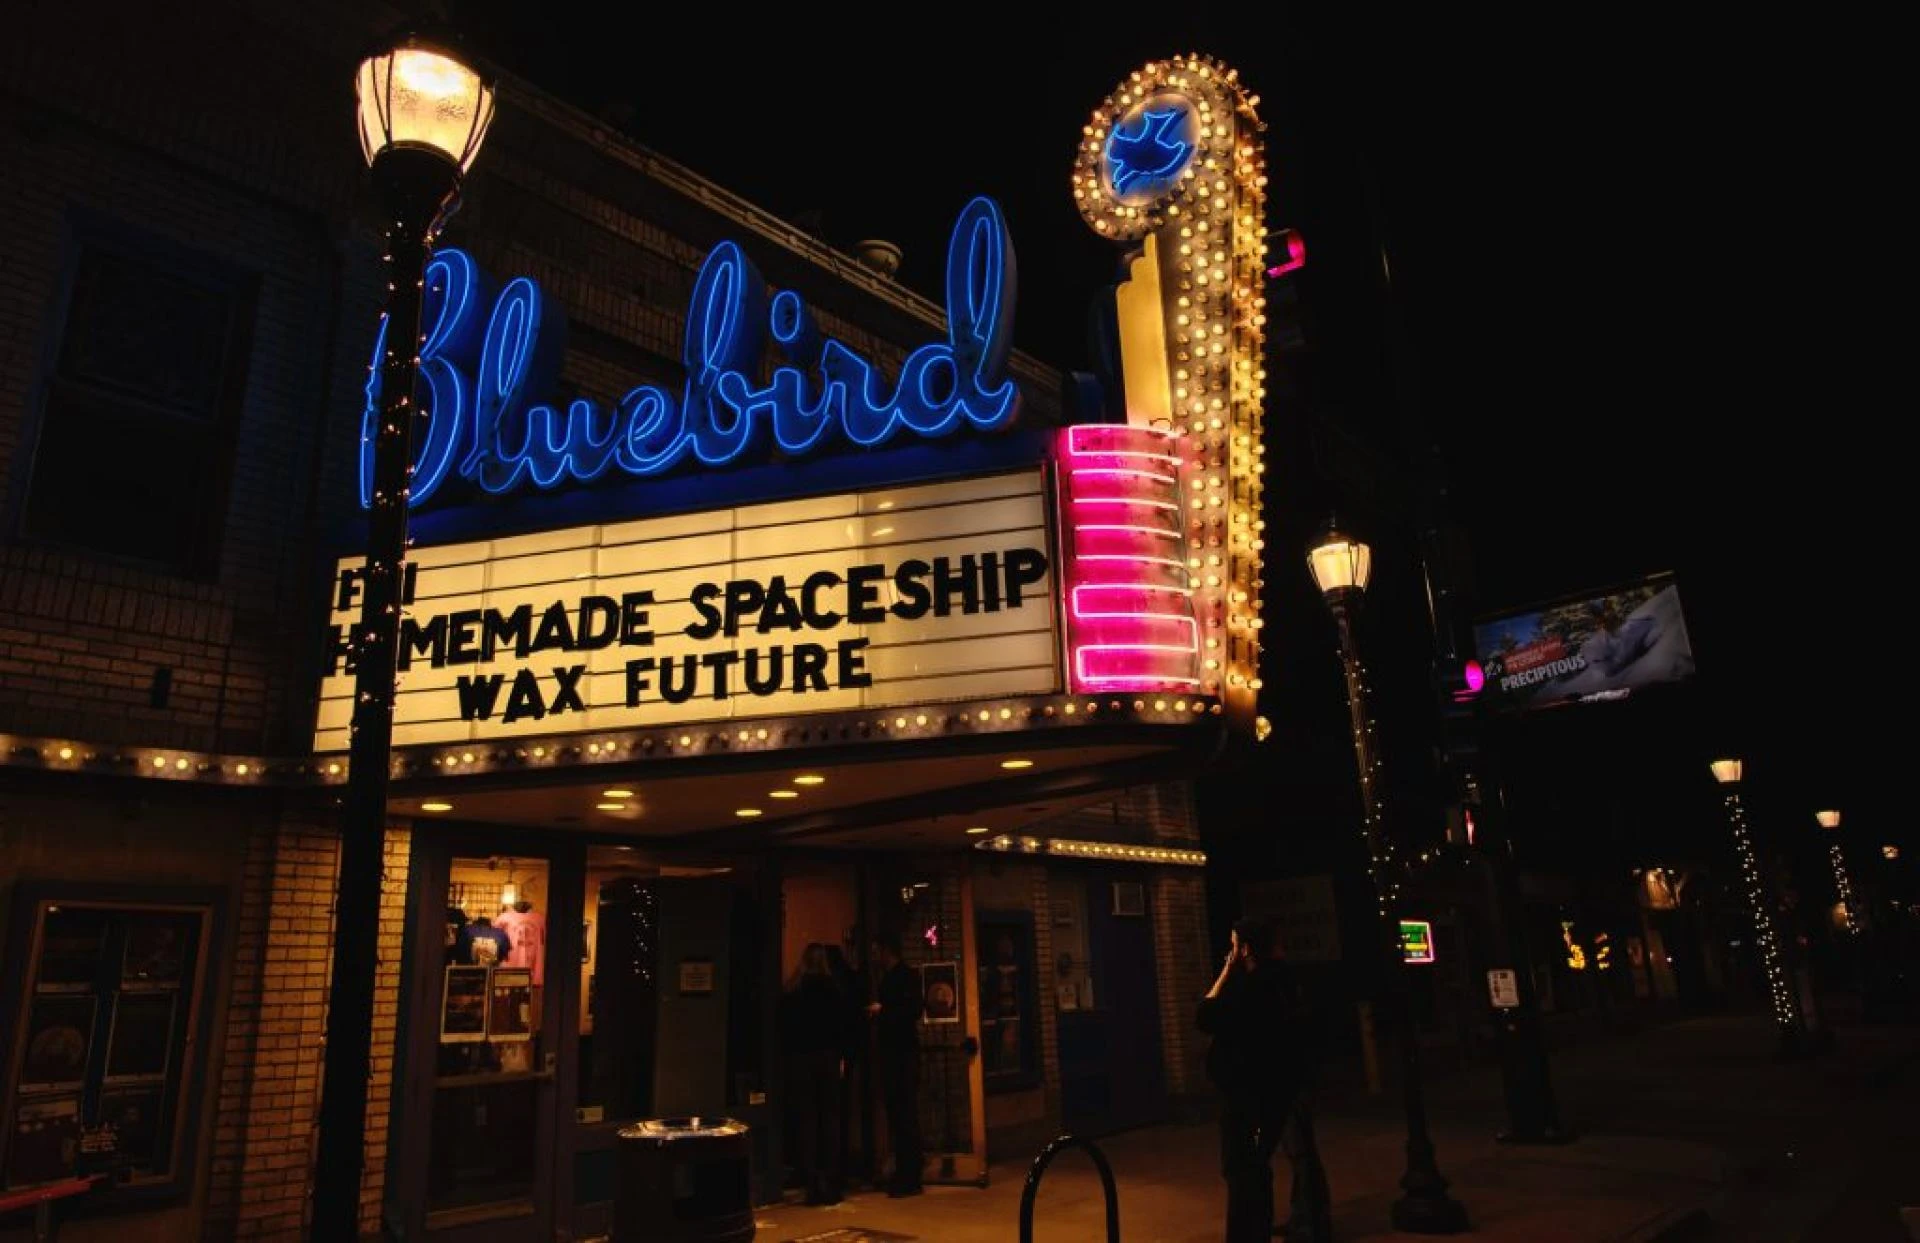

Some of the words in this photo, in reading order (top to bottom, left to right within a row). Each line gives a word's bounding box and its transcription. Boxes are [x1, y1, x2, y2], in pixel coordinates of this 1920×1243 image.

[359, 195, 1017, 508] Bluebird
[325, 590, 655, 676] HMEMADE
[684, 548, 1048, 640] SPACESHIP
[338, 562, 418, 611] FI
[456, 664, 587, 724] WAX
[625, 637, 873, 709] FUTURE
[1500, 653, 1586, 692] PRECIPITOUS
